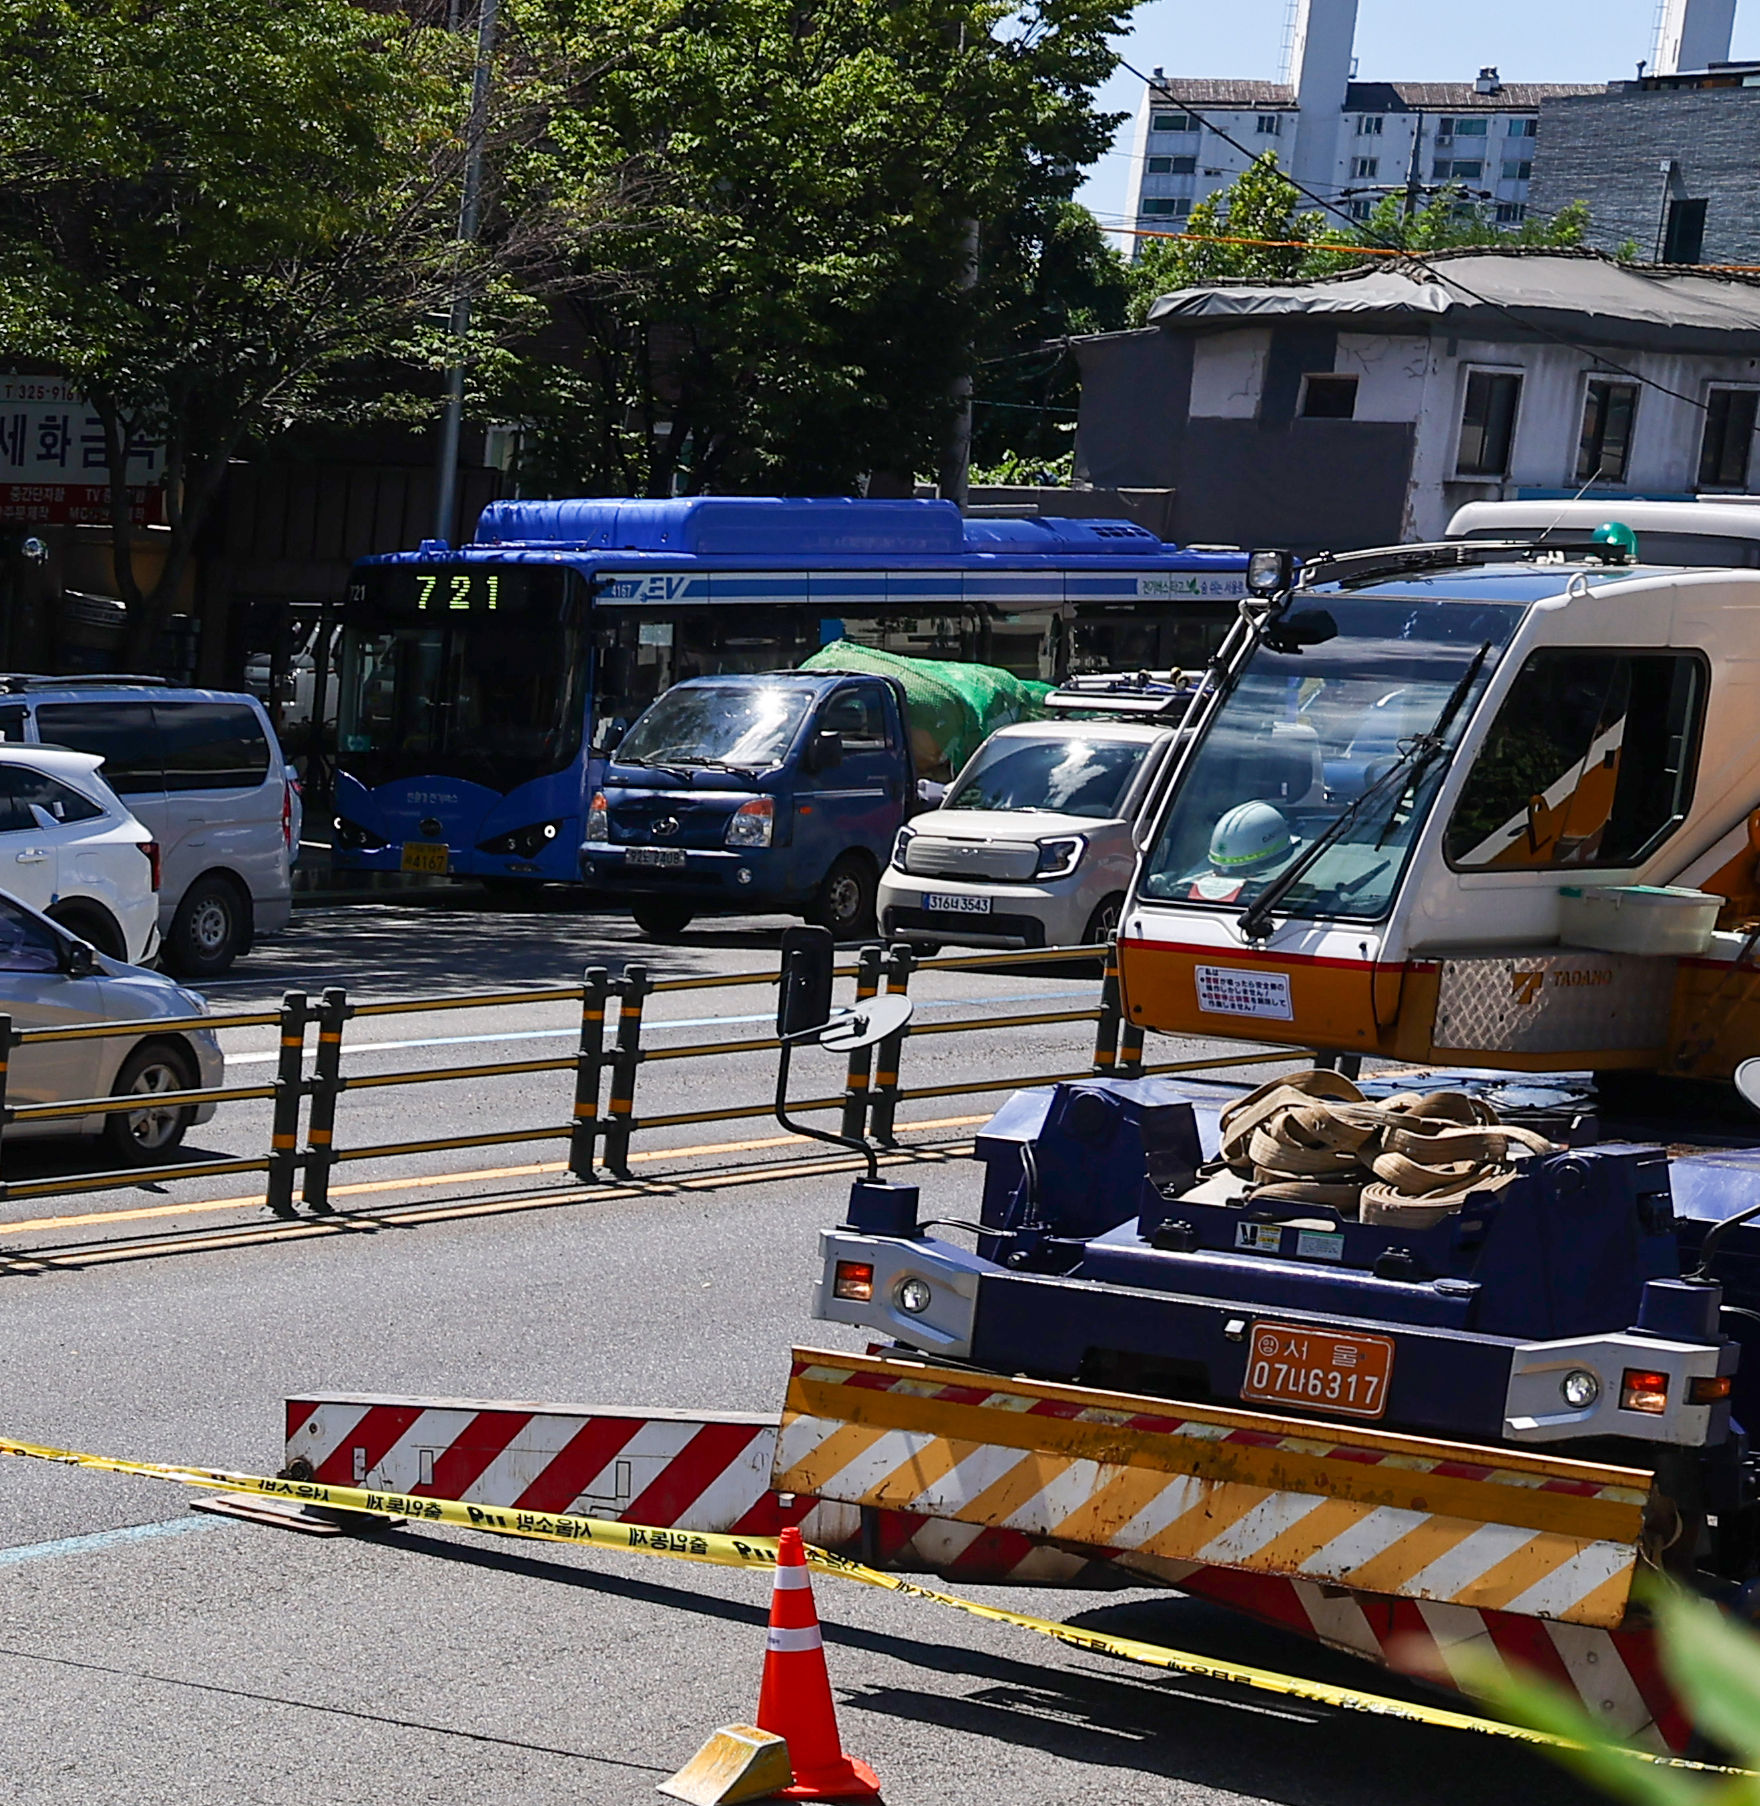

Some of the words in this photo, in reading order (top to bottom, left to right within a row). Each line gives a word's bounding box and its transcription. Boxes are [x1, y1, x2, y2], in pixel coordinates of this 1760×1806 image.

[19, 384, 83, 401] 325-916
[416, 576, 499, 610] 721
[611, 584, 632, 598] 4167
[960, 898, 989, 912] 3543
[1252, 1360, 1380, 1405] 07나6317
